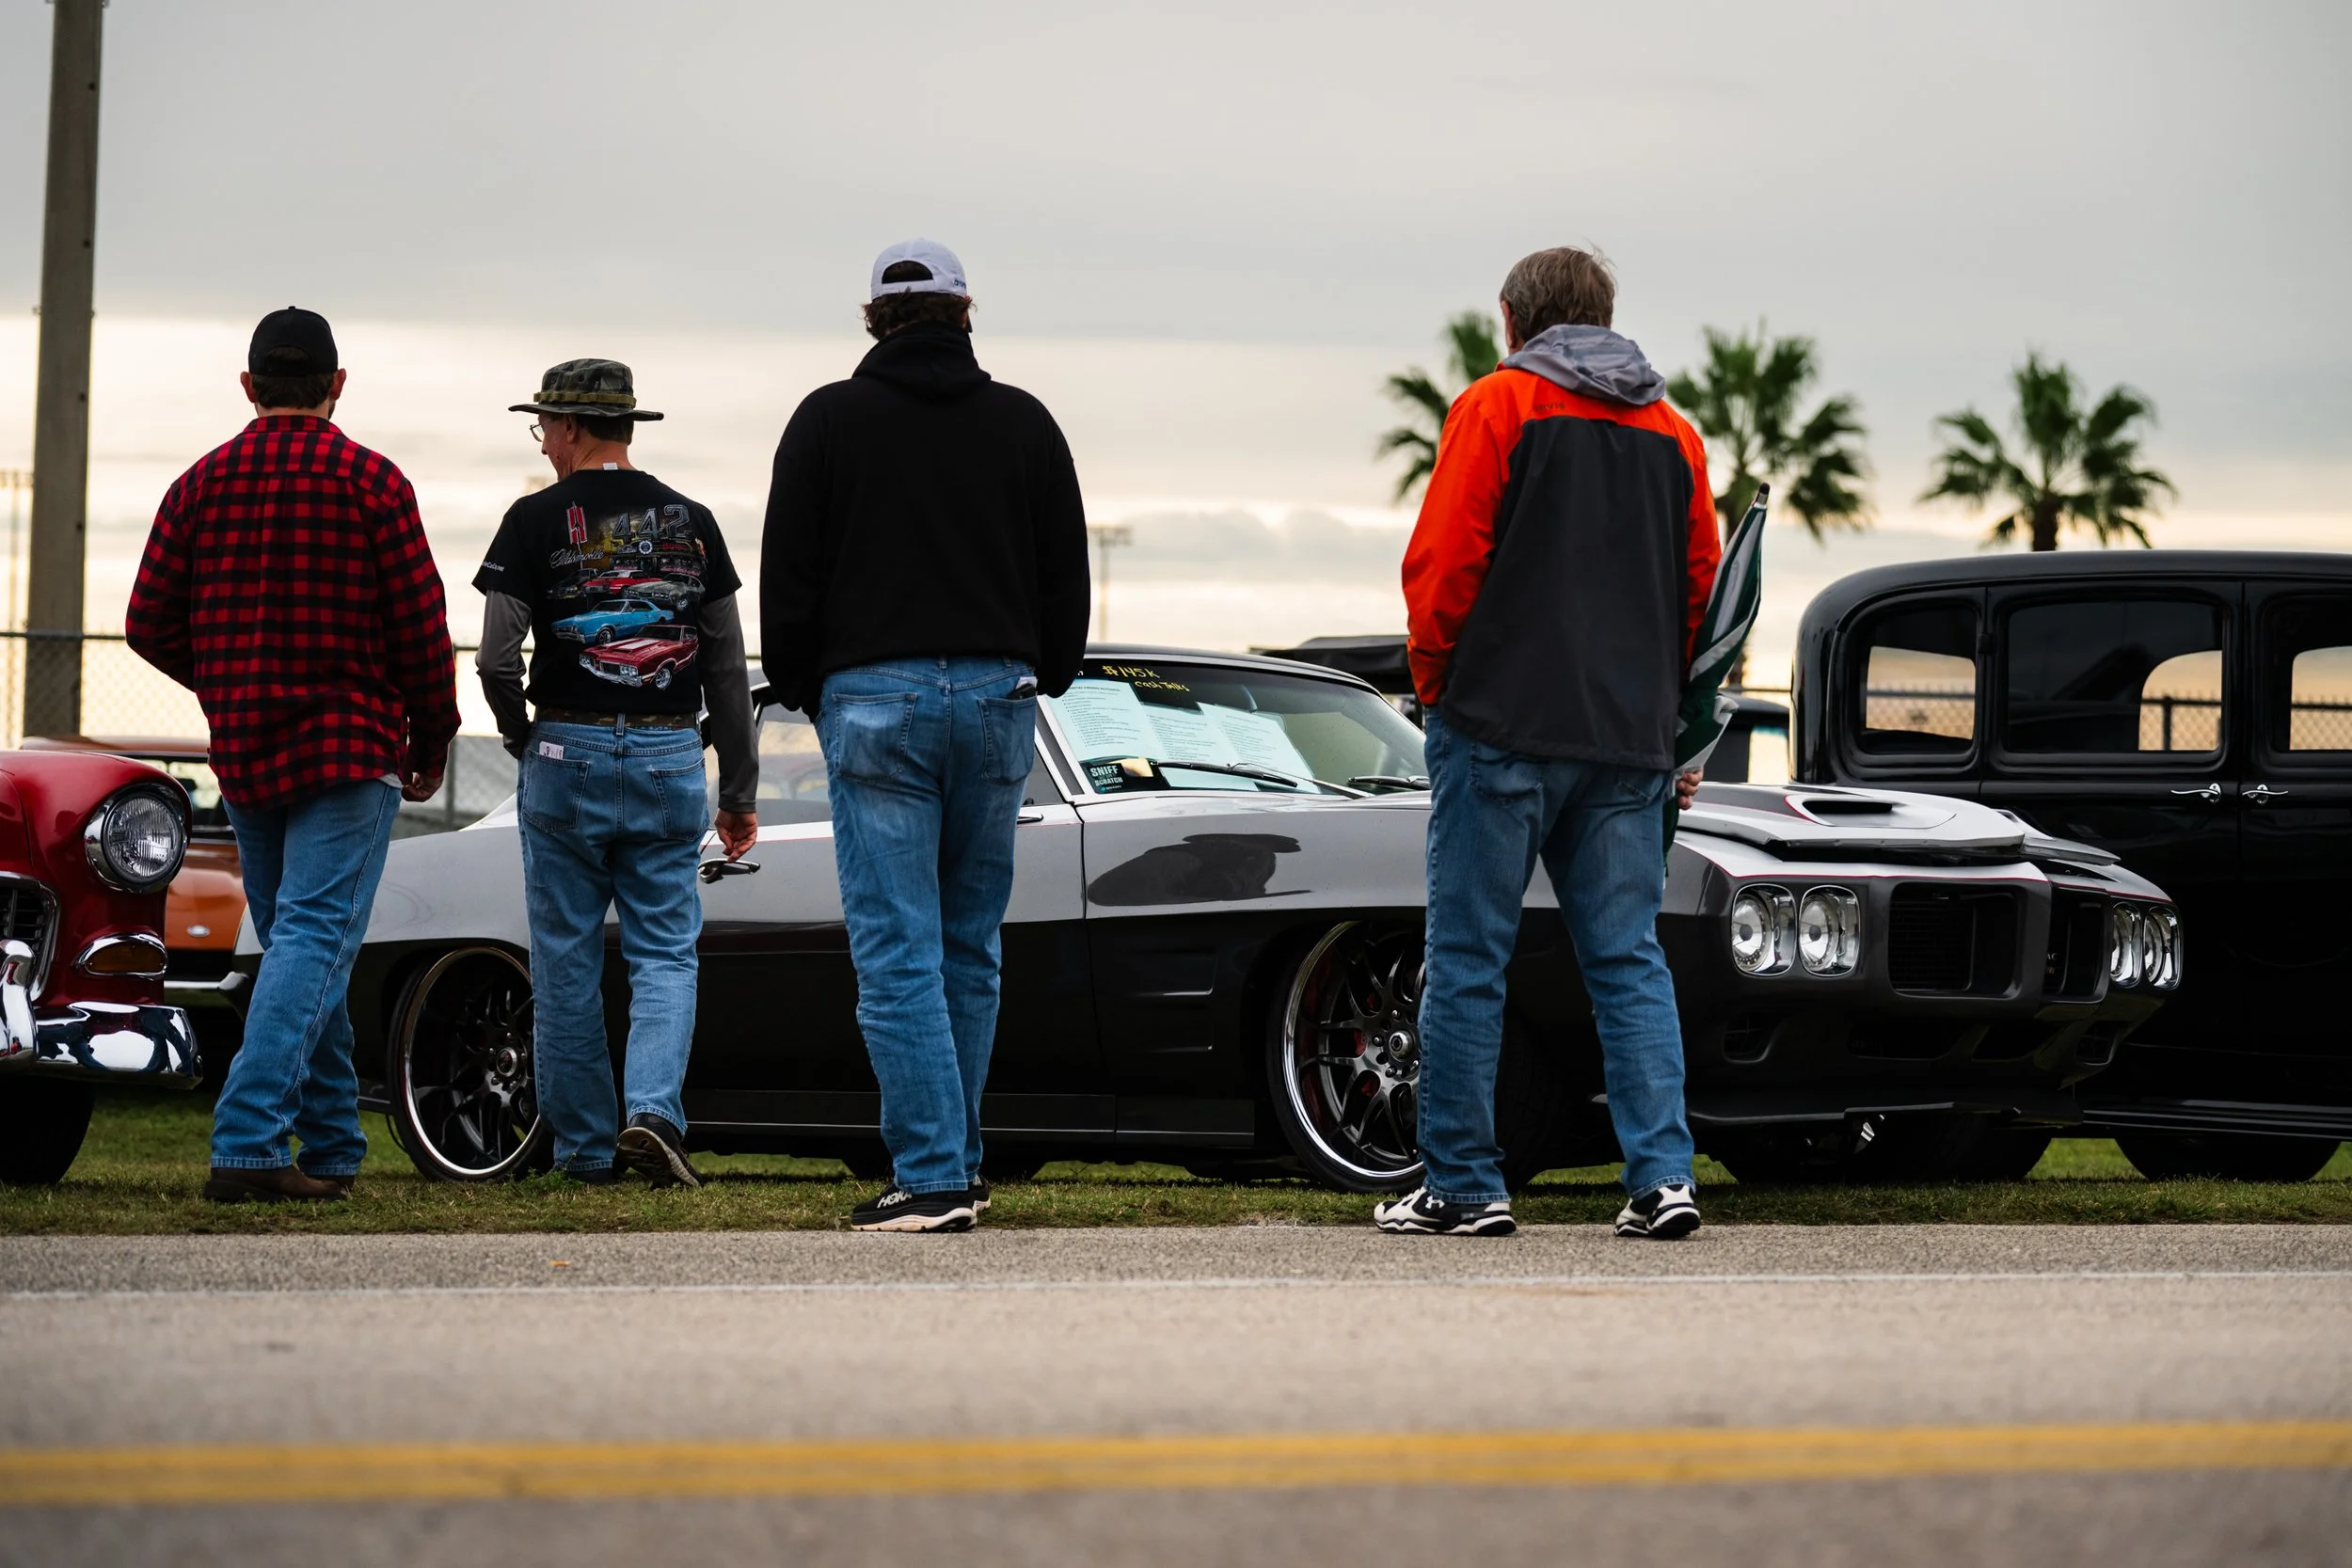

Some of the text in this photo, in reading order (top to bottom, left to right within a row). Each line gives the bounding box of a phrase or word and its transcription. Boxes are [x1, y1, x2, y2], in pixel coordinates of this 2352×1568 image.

[1089, 765, 1119, 777] SNIFF
[1094, 776, 1123, 786] SCRATCH
[876, 1190, 913, 1209] HOKA
